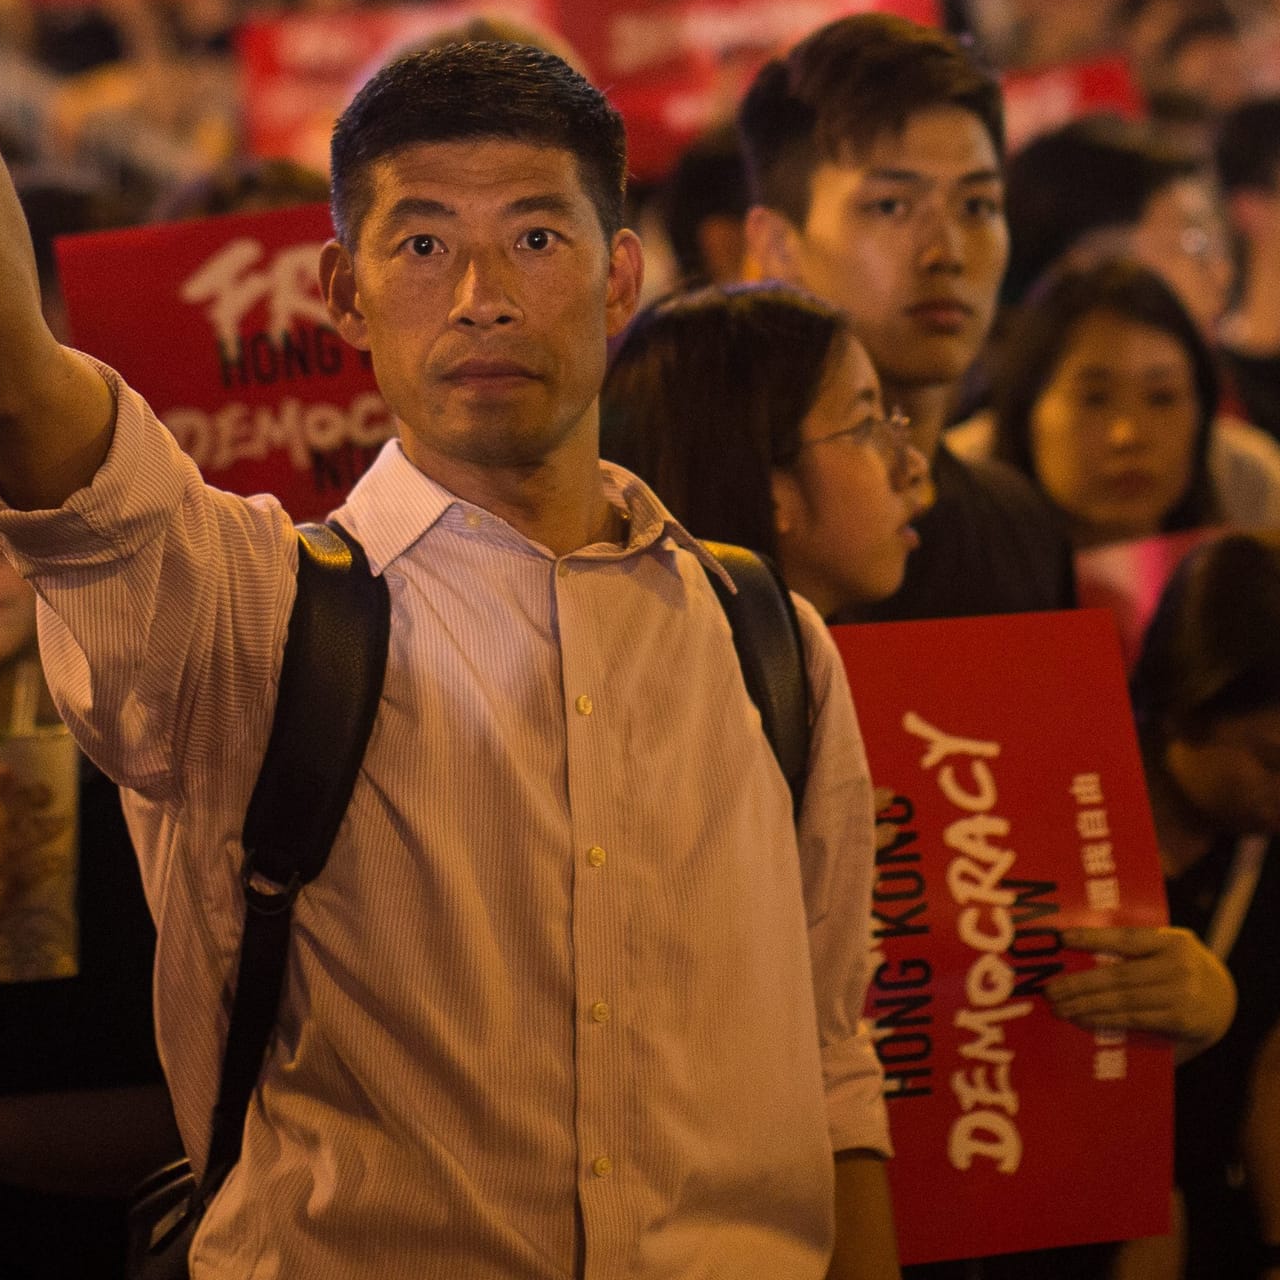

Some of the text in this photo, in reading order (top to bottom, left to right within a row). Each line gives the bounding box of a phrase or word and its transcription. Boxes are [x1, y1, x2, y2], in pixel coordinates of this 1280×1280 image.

[179, 237, 337, 365] FR
[219, 327, 343, 388] HONG
[164, 394, 395, 469] DEMOC
[901, 711, 1034, 1174] DEMOCRACY
[1008, 877, 1066, 1000] NOW
[873, 957, 933, 1101] HONG
